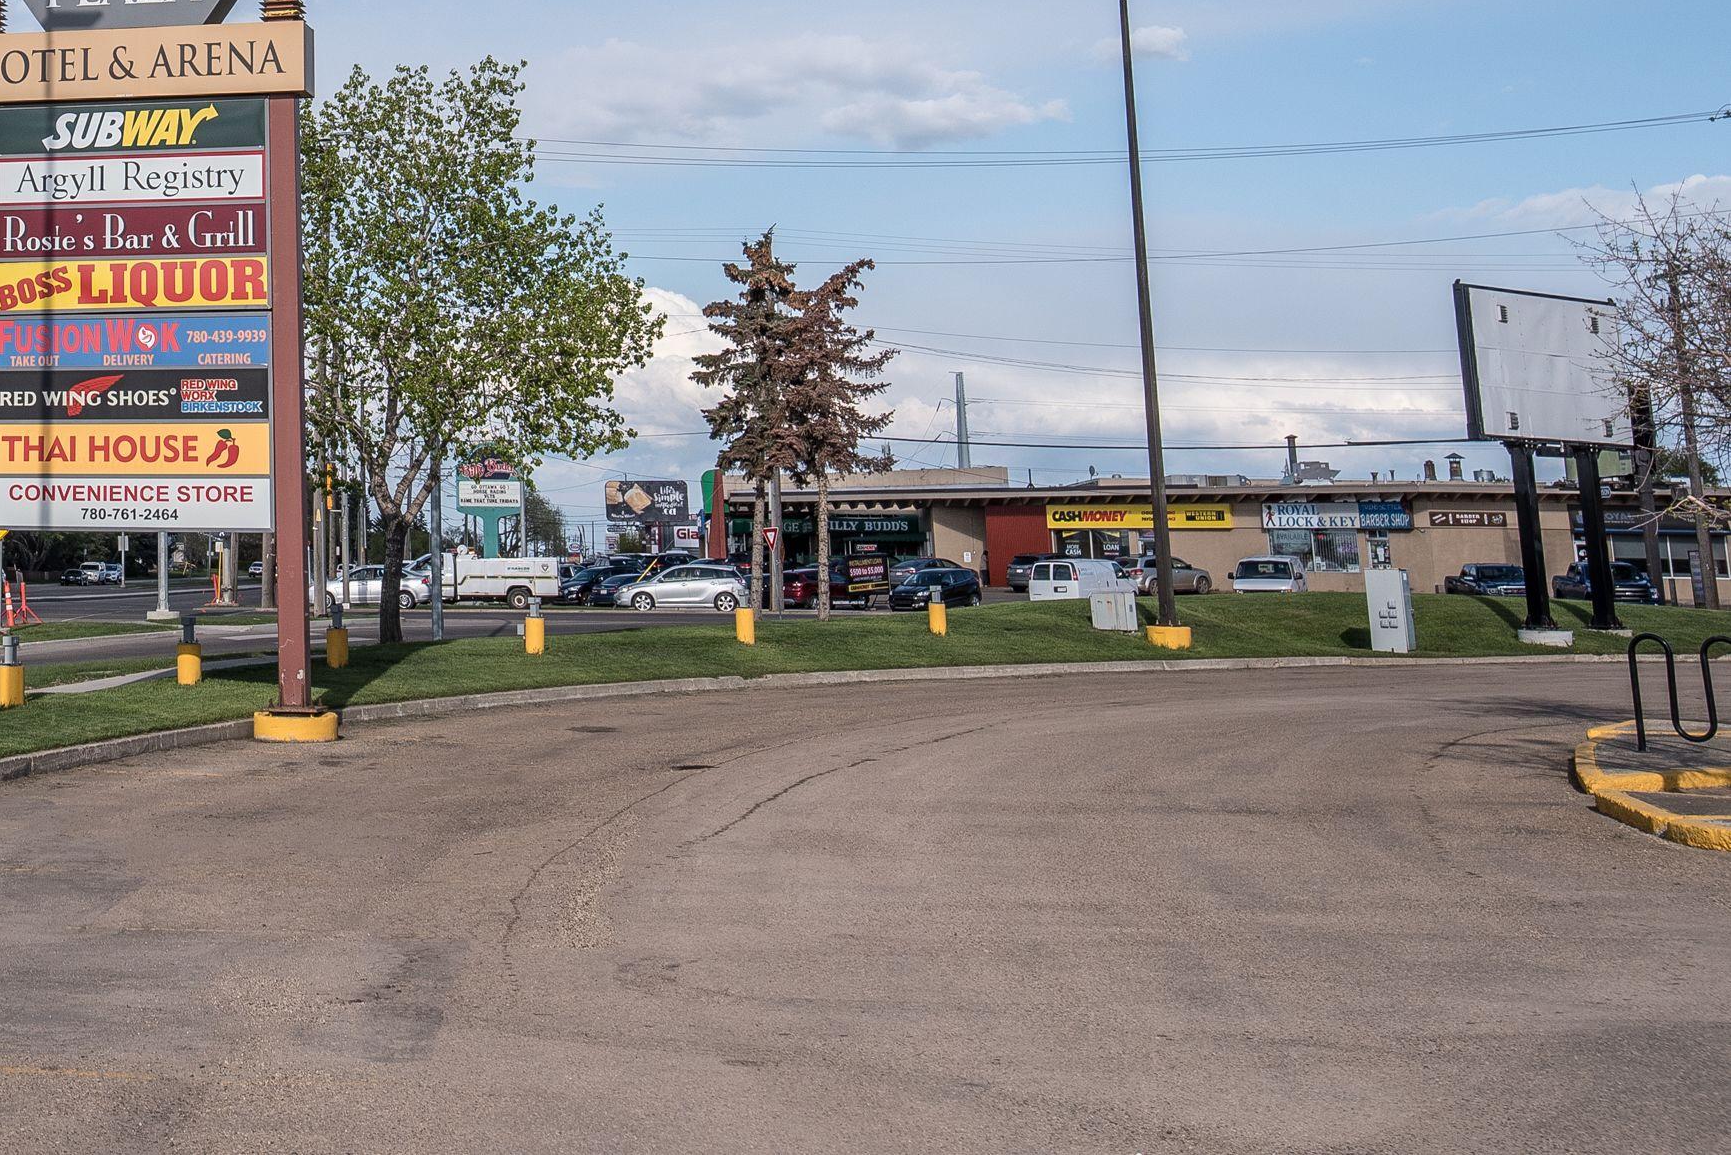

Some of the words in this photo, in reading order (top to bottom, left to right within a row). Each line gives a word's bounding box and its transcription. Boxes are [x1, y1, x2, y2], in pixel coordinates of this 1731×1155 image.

[108, 45, 140, 80] &
[148, 40, 287, 79] ARENA
[42, 103, 219, 152] SUBWAY
[15, 163, 105, 200] Argyll
[122, 162, 245, 196] Registry
[3, 214, 95, 252] Rosie's
[102, 214, 154, 250] Bar
[161, 224, 181, 248] &
[188, 210, 256, 248] Grill
[77, 259, 267, 307] LIQUOR
[105, 319, 181, 353] WOK
[186, 329, 267, 343] 780-439-9939
[10, 355, 36, 366] TAKE
[38, 355, 60, 366] OUT
[103, 354, 154, 366] DELIVERY
[198, 353, 251, 365] CATERING
[181, 379, 204, 391] RED
[206, 379, 237, 391] WING
[0, 391, 37, 406] RED
[43, 390, 101, 406] WING
[107, 390, 169, 406] SHOES
[181, 390, 217, 401] WORX
[181, 401, 263, 413] BIRKENSTOCK
[2, 435, 76, 462] THAI
[89, 435, 199, 462] HOUSE
[9, 484, 169, 502] CONVENIENCE
[177, 485, 253, 502] STORE
[81, 508, 179, 521] 780-761-2464
[1277, 505, 1319, 515] ROYAL
[829, 521, 859, 531] ILLY
[864, 521, 908, 531] BUDD'S
[1277, 516, 1315, 527] LOCK
[1317, 516, 1328, 527] &
[1329, 516, 1357, 527] KEY
[1360, 514, 1390, 527] BARBER
[1390, 513, 1409, 527] SHOP
